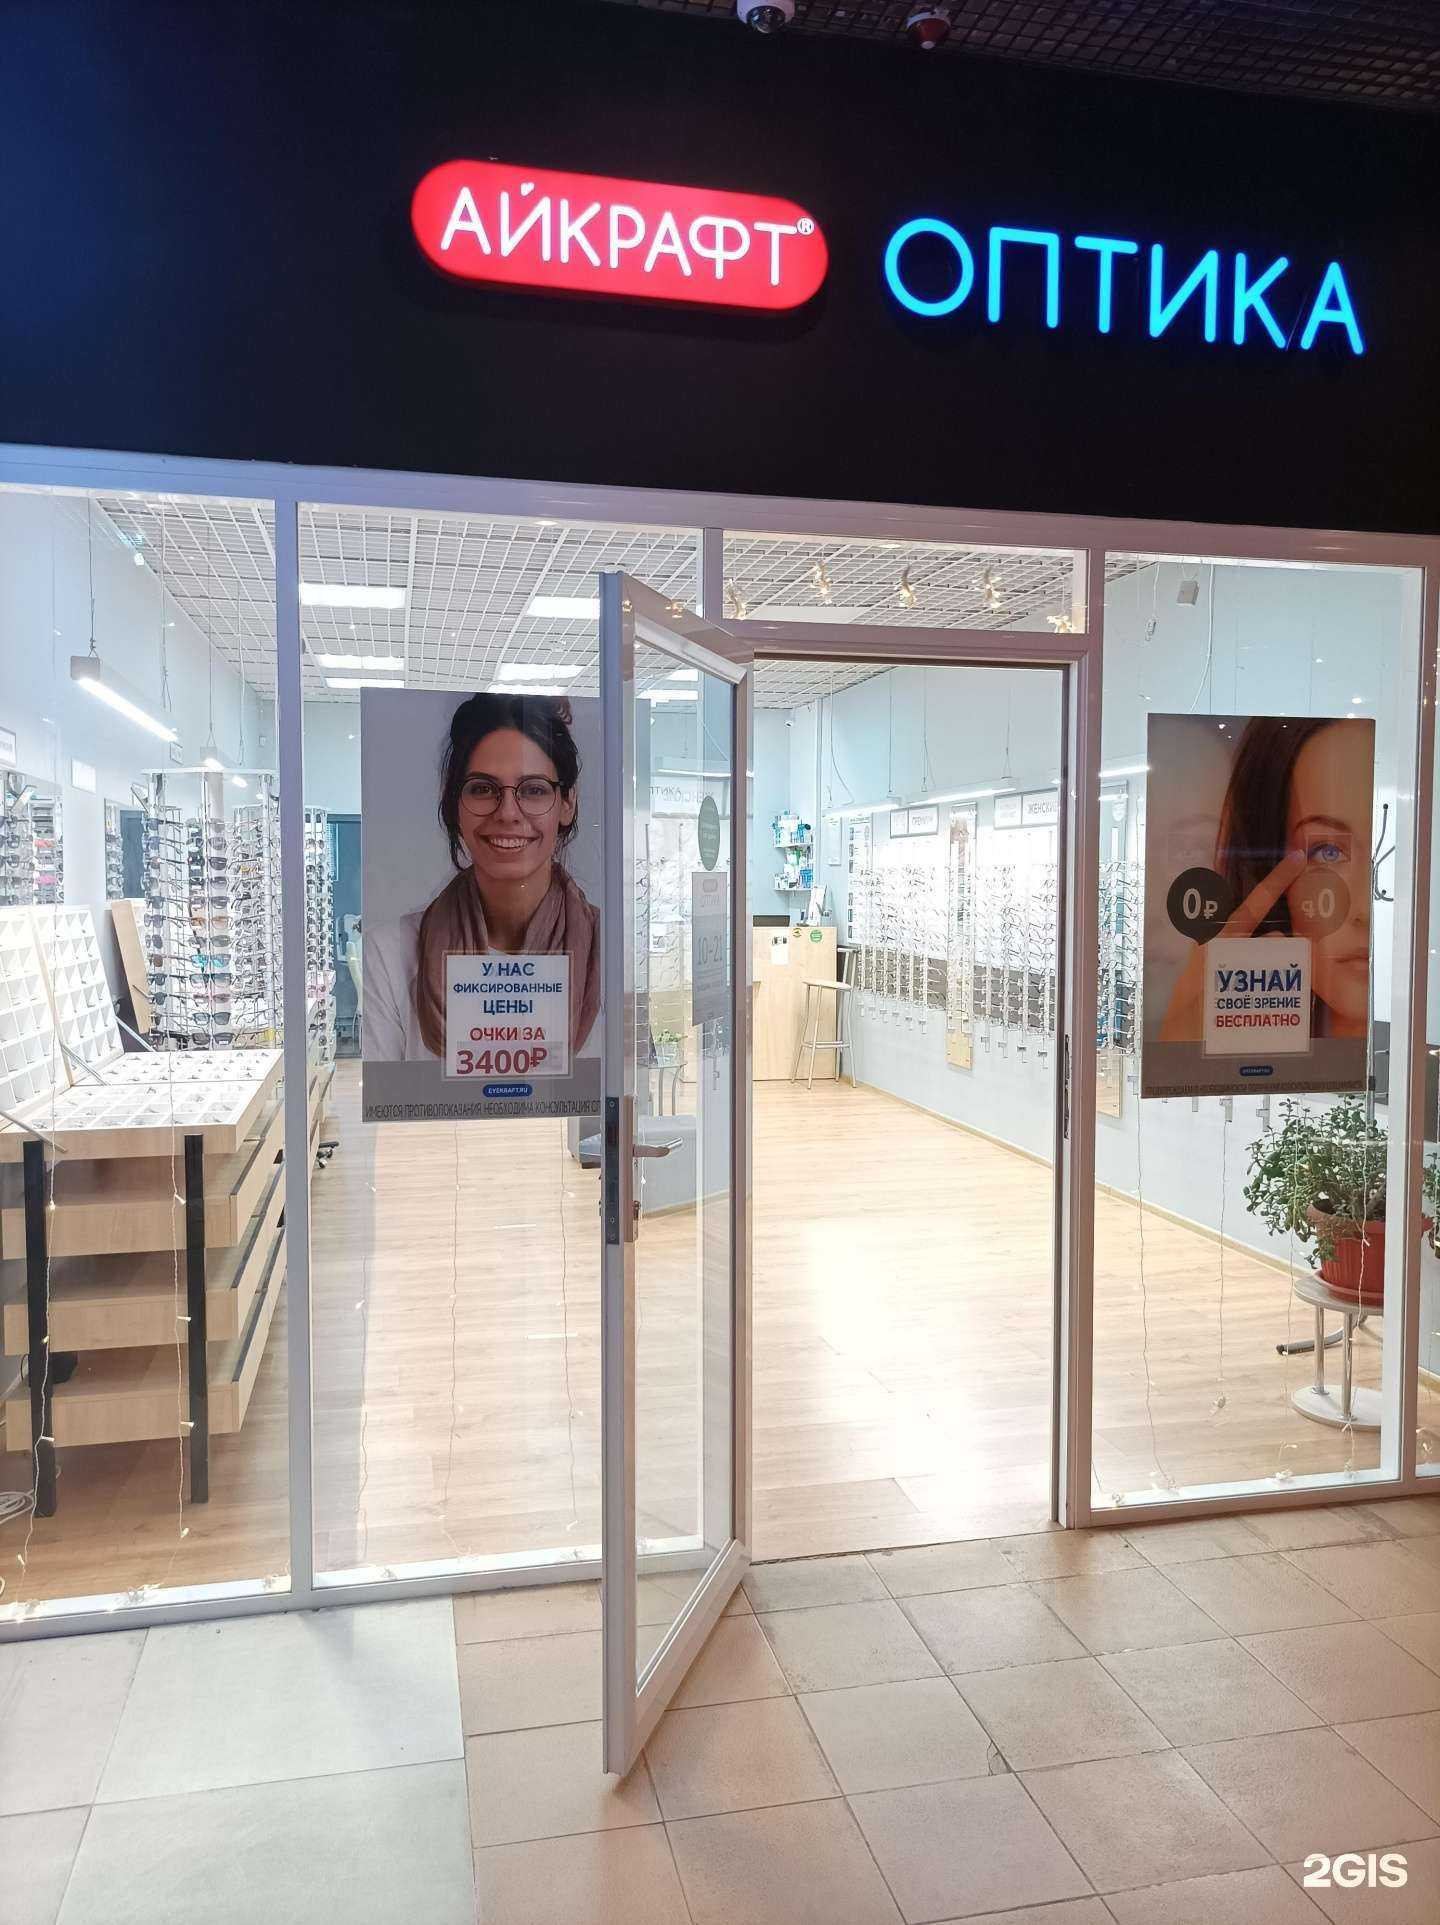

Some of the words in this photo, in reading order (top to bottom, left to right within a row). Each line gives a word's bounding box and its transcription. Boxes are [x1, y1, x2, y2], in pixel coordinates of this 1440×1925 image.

[885, 218, 1364, 354] ОПТИКА
[482, 962, 493, 976] У
[498, 962, 535, 976] НАС
[1218, 963, 1301, 992] УЗНАЙ
[453, 983, 562, 993] ФИКСИРОВАННЫЕ
[483, 1000, 533, 1015] ЦЕНЫ
[1217, 995, 1251, 1009] СВОЁ
[1254, 997, 1301, 1009] ЗРЕНИЕ
[1216, 1014, 1300, 1028] БЕСПЛАТНО
[470, 1027, 518, 1041] ОЧКИ
[523, 1027, 545, 1041] ЗА
